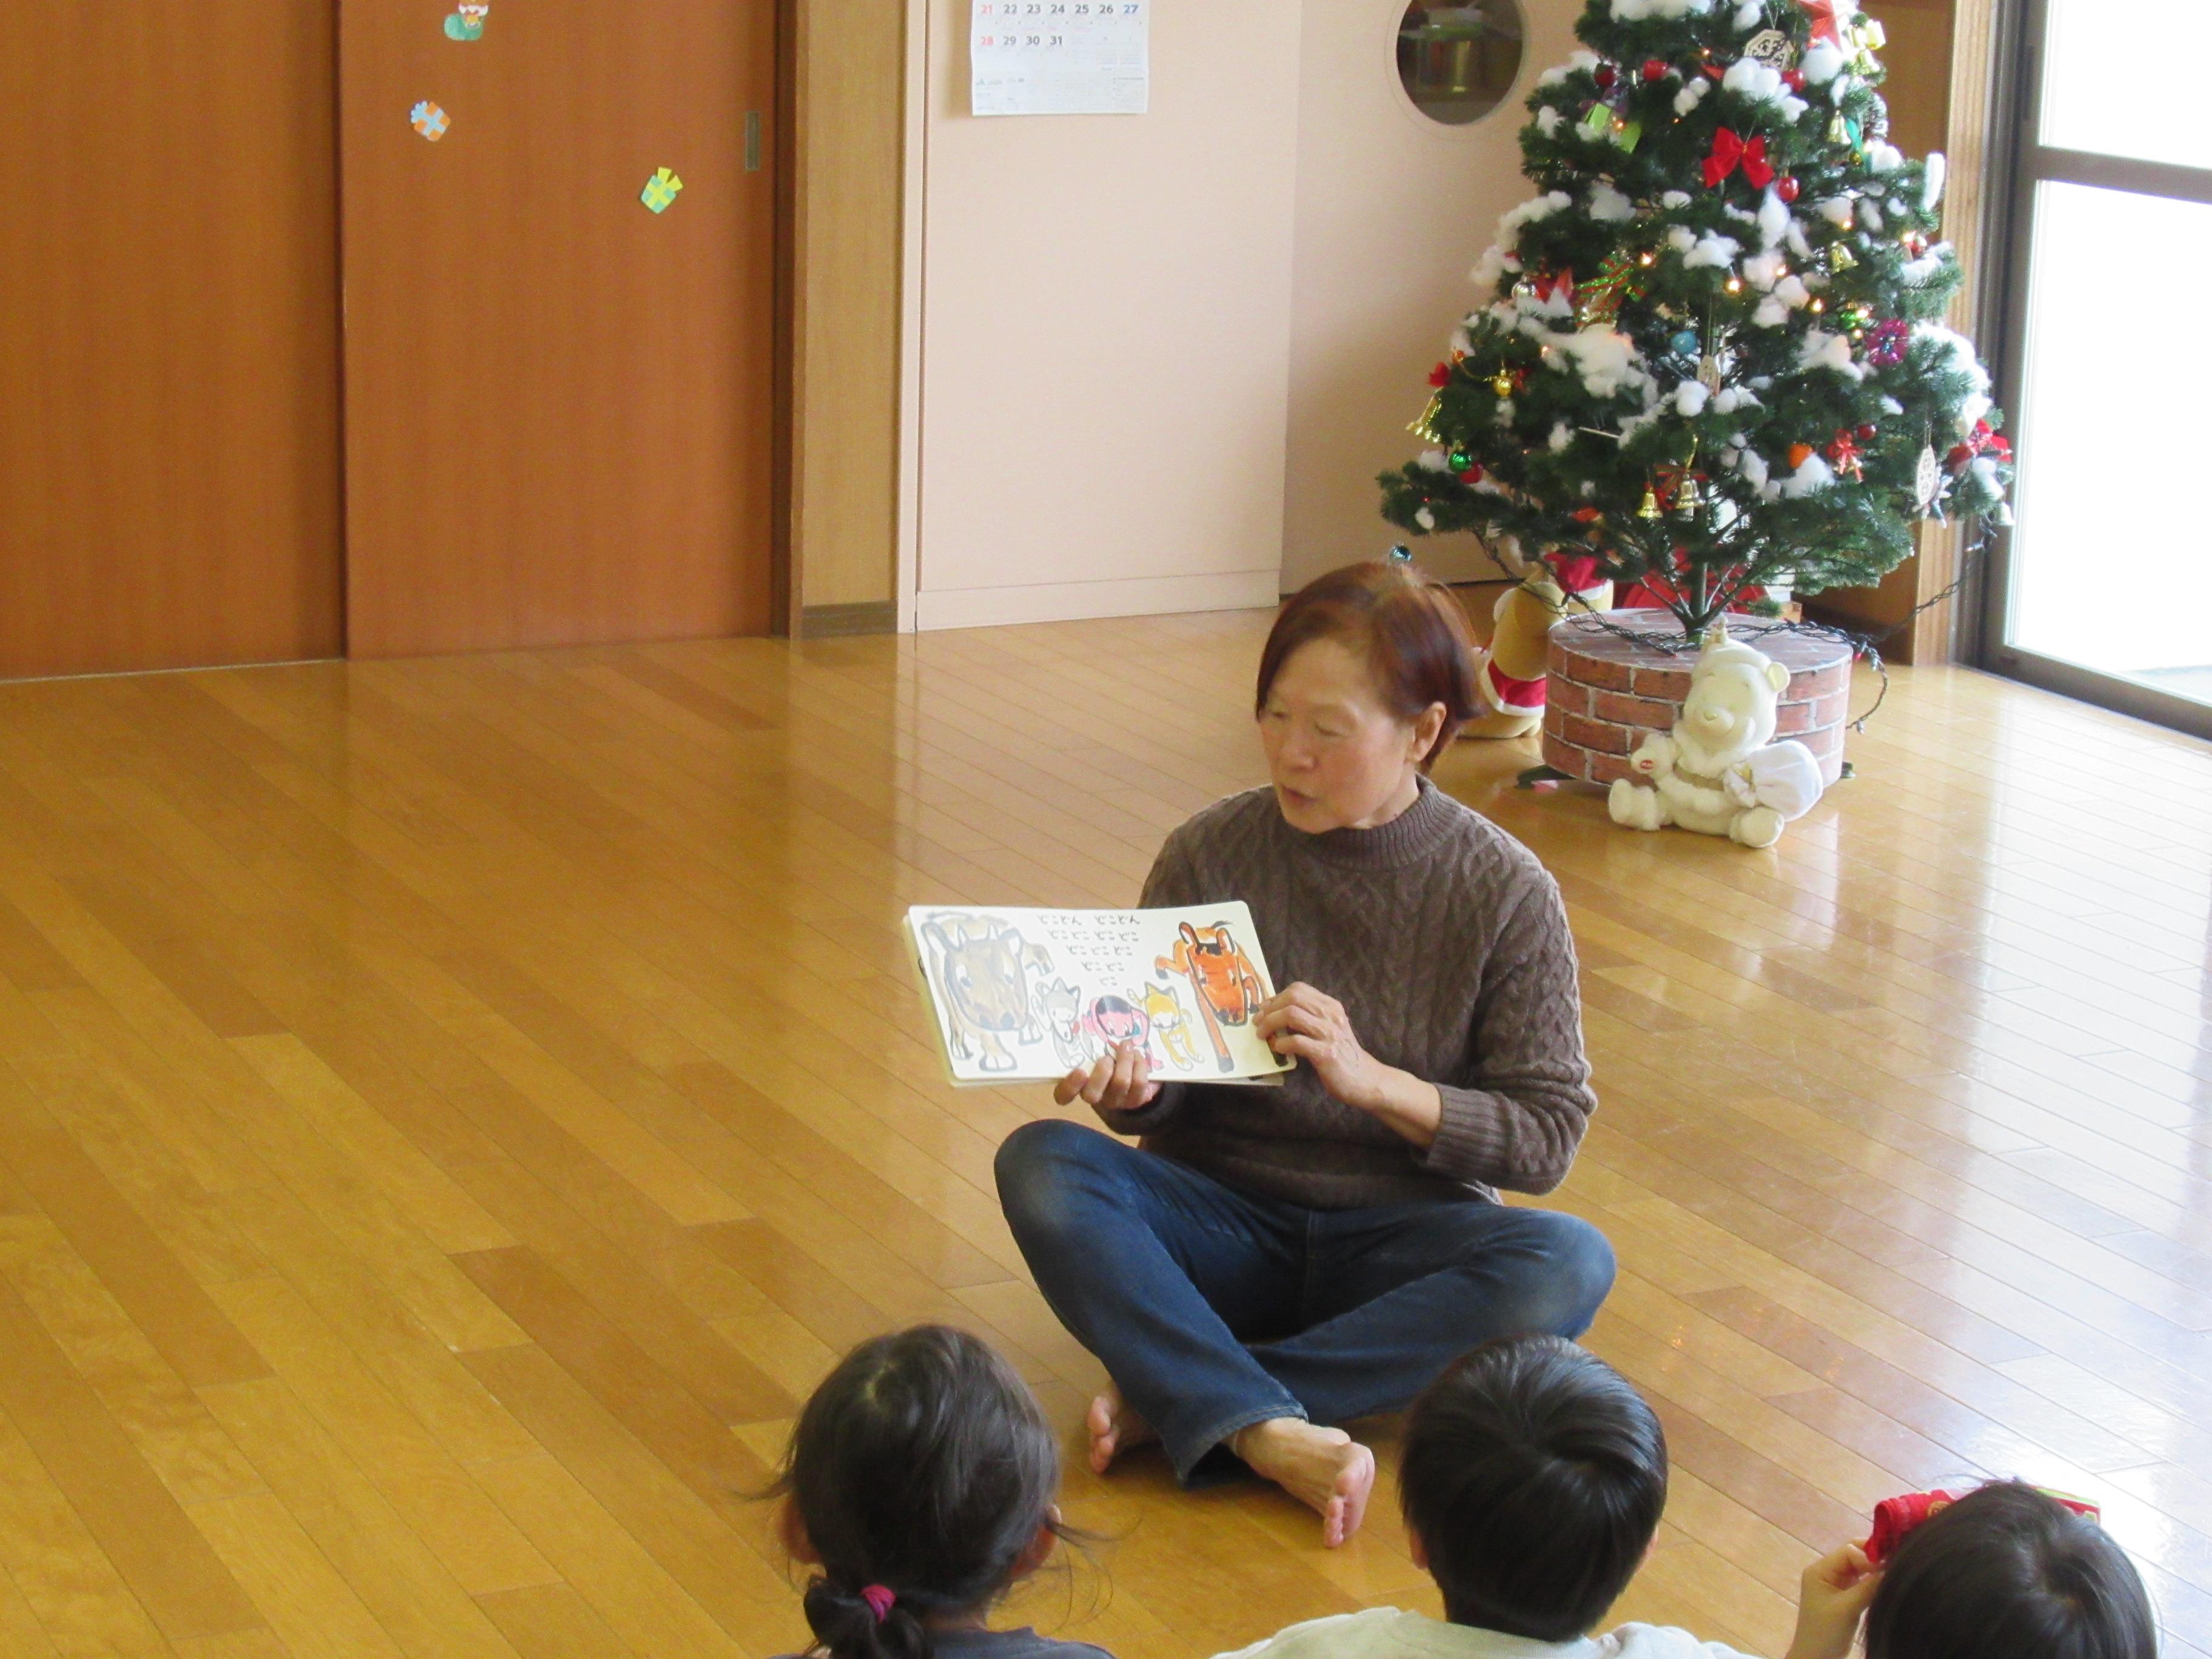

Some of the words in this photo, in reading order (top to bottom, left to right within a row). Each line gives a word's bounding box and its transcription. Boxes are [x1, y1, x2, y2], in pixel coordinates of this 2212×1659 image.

[981, 4, 993, 14] 21
[1004, 4, 1018, 14] 22
[1027, 4, 1041, 14] 23
[1050, 4, 1065, 15] 24
[1074, 4, 1090, 15] 25
[1099, 4, 1114, 15] 26
[1123, 4, 1139, 15] 27
[980, 36, 994, 45] 28
[1003, 36, 1017, 45] 29
[1026, 35, 1041, 46] 30
[1050, 35, 1064, 46] 31
